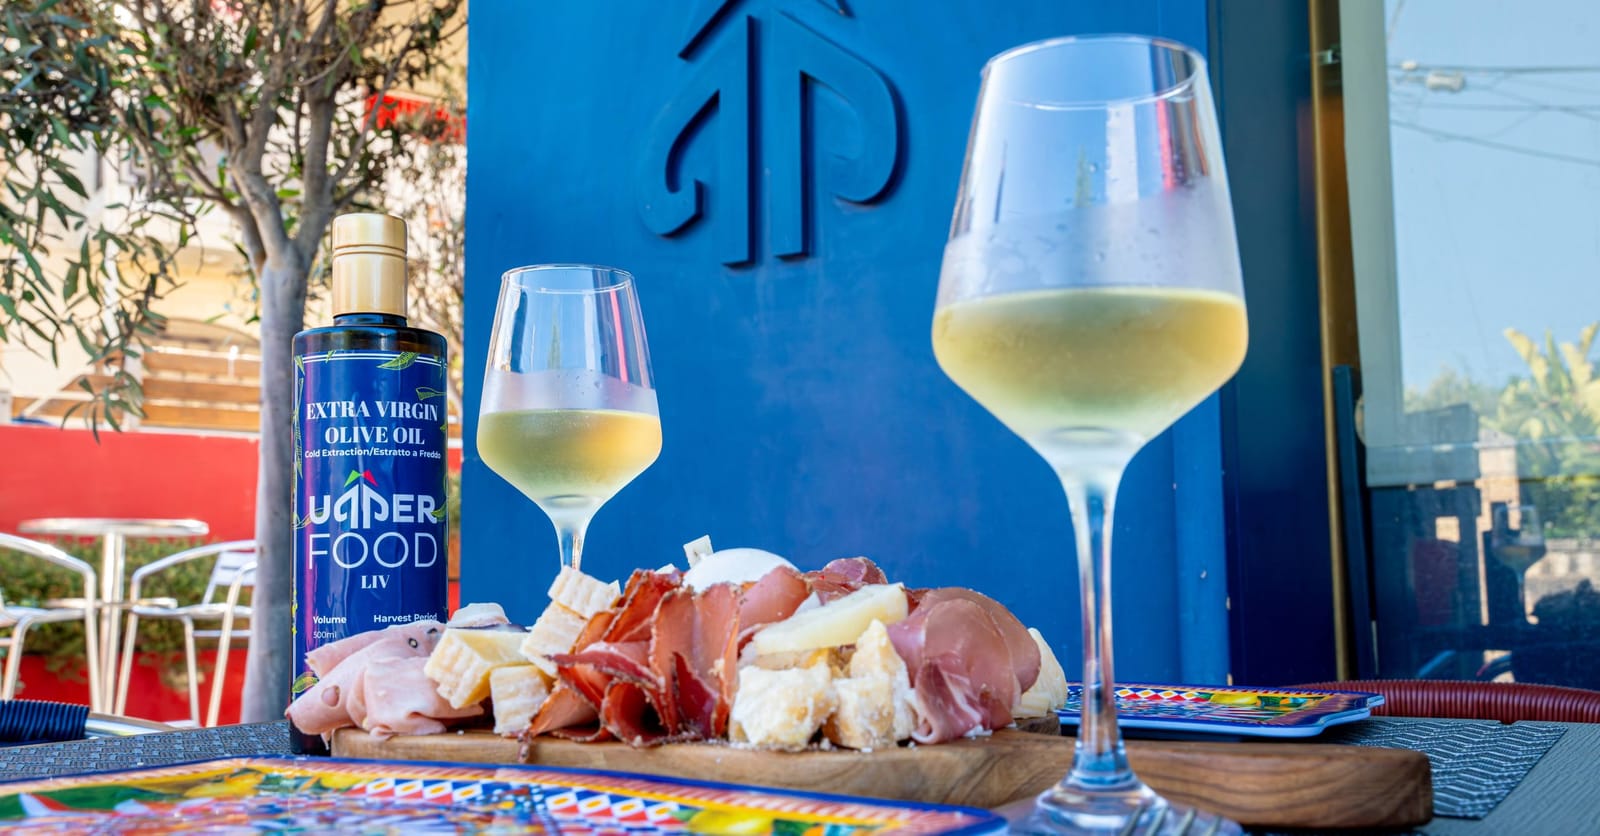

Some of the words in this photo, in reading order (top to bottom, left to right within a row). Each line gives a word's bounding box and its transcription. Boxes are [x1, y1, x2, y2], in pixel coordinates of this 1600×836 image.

[306, 401, 371, 420] EXTRA
[375, 401, 438, 421] VIRGIN
[325, 426, 388, 444] OLIVE
[393, 427, 425, 445] OIL
[304, 450, 320, 458] Cold
[322, 447, 410, 457] Extraction/Estratto
[419, 450, 441, 459] Freddo
[309, 532, 437, 569] FOOD
[361, 574, 390, 589] LIV
[313, 616, 347, 624] Volume
[373, 614, 411, 623] Harvest
[414, 612, 438, 622] Period
[313, 631, 337, 639] 500ml
